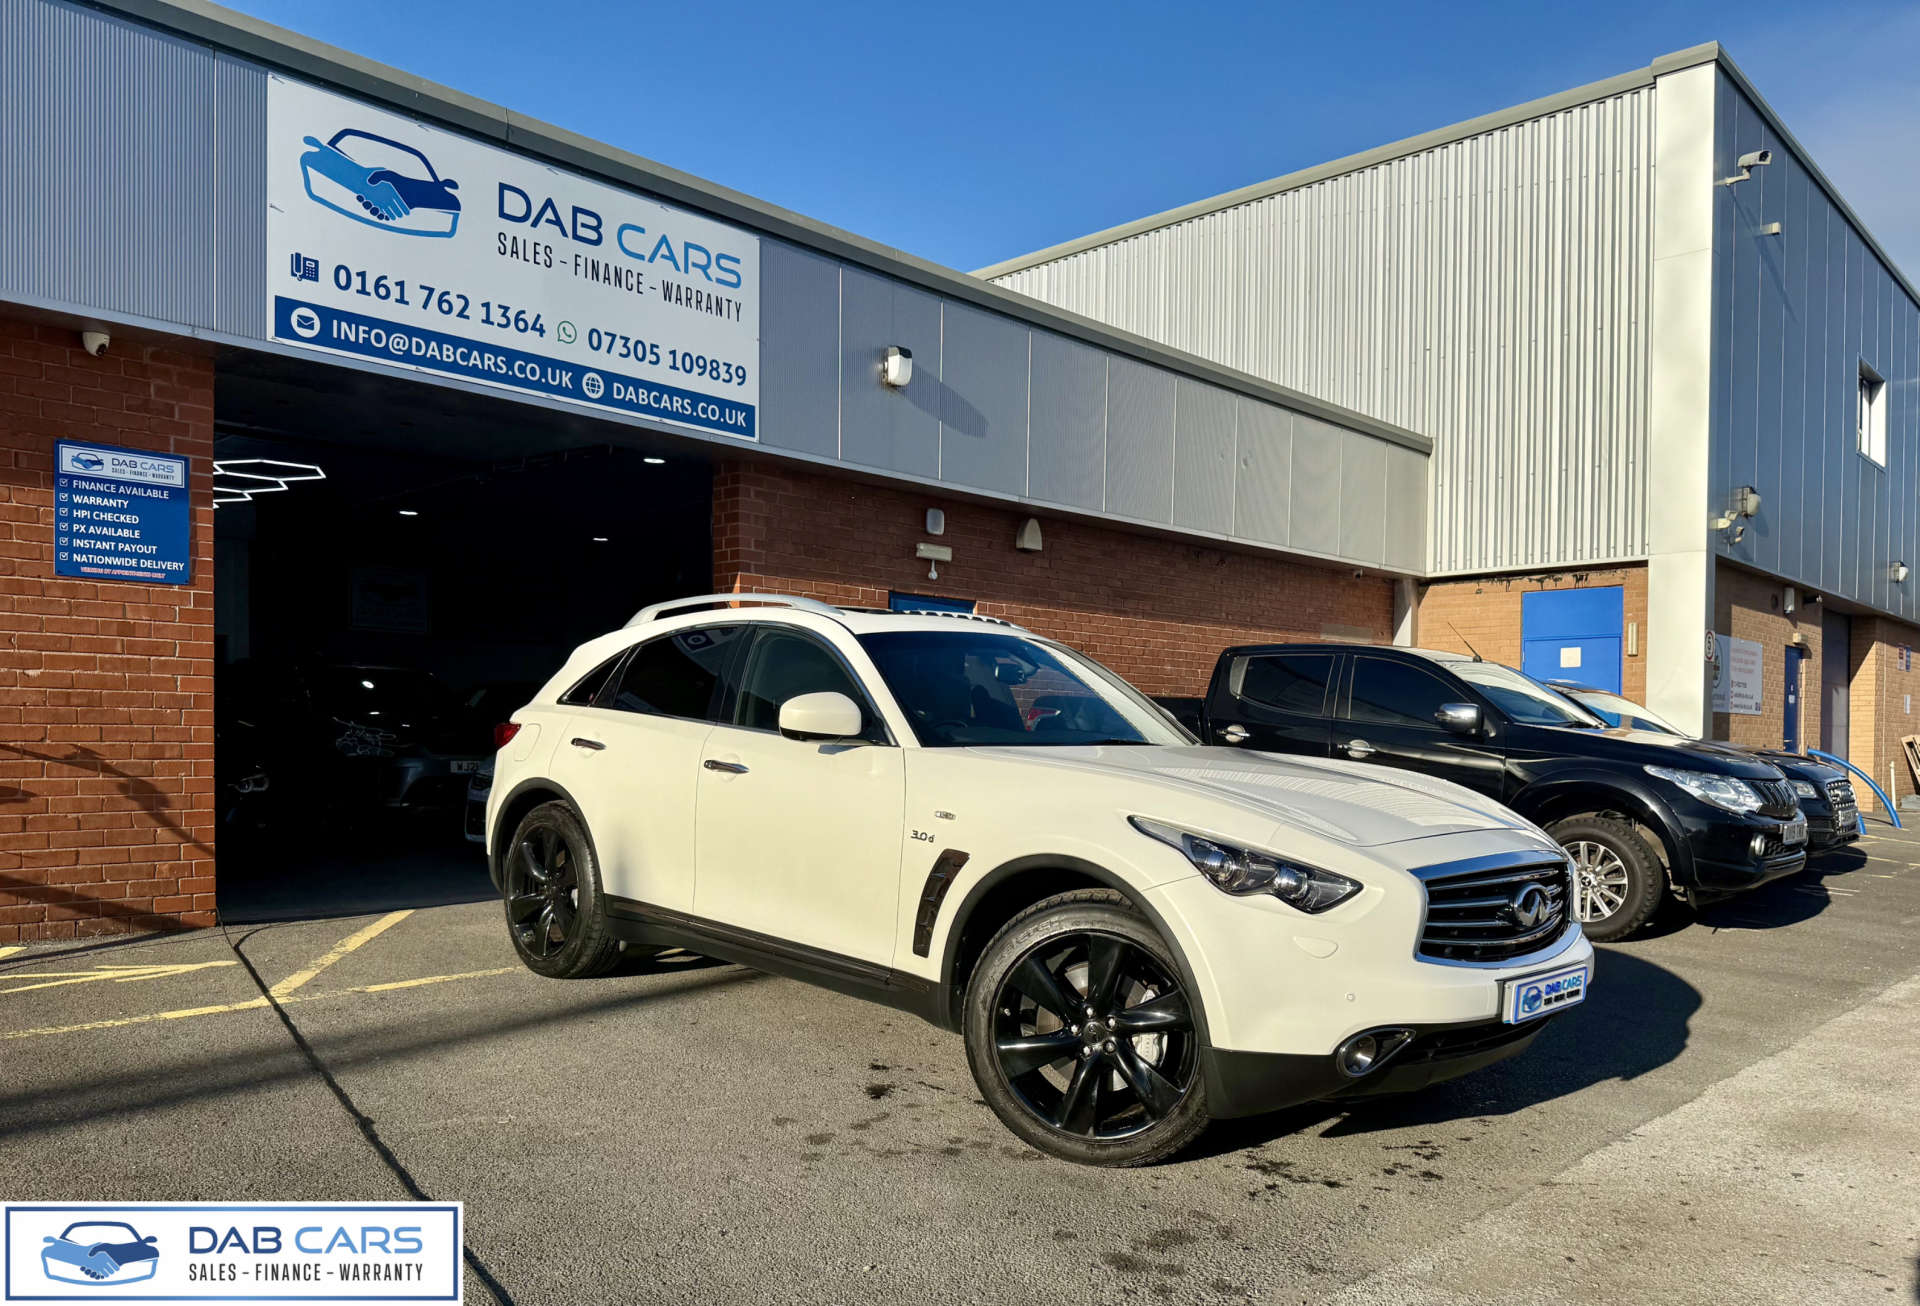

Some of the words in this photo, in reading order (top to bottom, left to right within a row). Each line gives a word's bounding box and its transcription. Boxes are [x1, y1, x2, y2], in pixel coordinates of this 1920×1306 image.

[498, 181, 603, 247] DAB
[616, 222, 742, 289] CARS
[497, 231, 553, 268] SALES
[574, 253, 644, 294] FINANCE
[662, 279, 742, 322] WARRANTY
[333, 264, 410, 306] 0161
[419, 284, 471, 320] 762
[481, 301, 546, 338] 1364
[331, 319, 573, 390] INFO@DABCARS.CO.UK
[588, 328, 661, 366] 07305
[668, 349, 747, 387] 109839
[612, 382, 747, 428] DABCARS.CO.UK
[111, 457, 138, 469] DAB
[139, 461, 175, 474] CARS
[72, 479, 116, 493] FINANCE
[118, 485, 169, 499] AVAILABLE
[72, 494, 129, 509] WARRANTY
[73, 509, 91, 520] HPI
[93, 511, 140, 525] CHECKED
[73, 523, 86, 534] PX
[88, 525, 141, 539] AVAILABLE
[73, 538, 116, 551] INSTANT
[118, 542, 158, 555] PAYOUT
[73, 553, 138, 568] NATIONWIDE
[140, 558, 185, 571] DELIVERY
[1561, 975, 1583, 990] CARS
